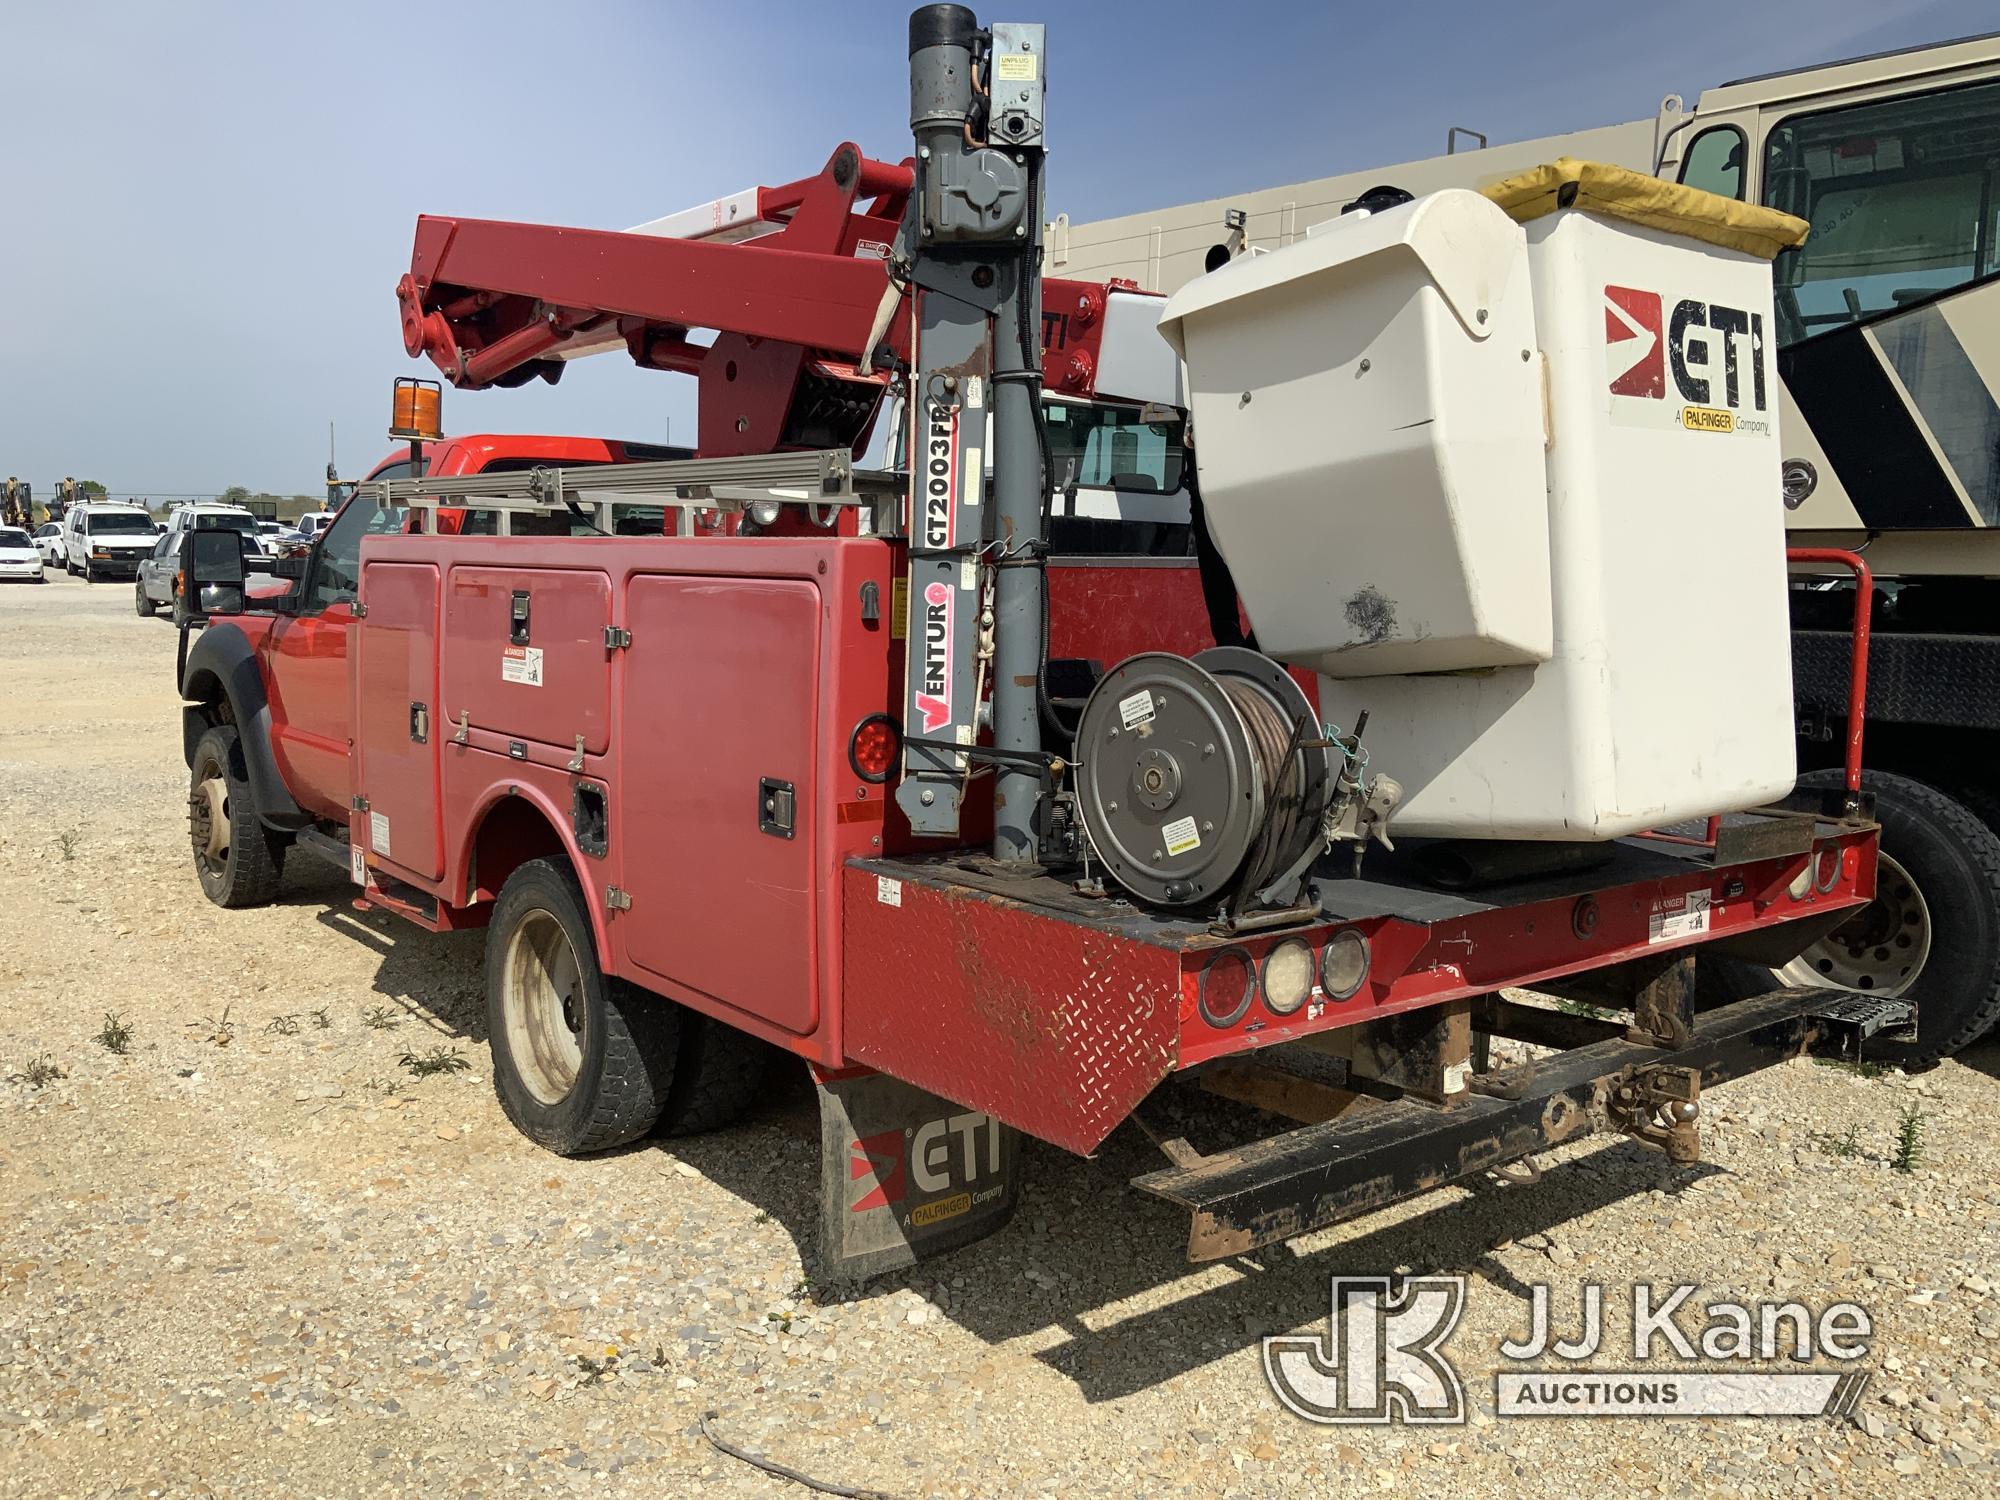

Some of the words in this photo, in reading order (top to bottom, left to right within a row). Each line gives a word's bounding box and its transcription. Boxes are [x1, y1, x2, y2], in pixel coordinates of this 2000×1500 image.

[1042, 311, 1069, 350] TI
[1669, 299, 1767, 412] ETI
[1675, 410, 1681, 424] A
[1686, 411, 1732, 428] PALFINGER
[1736, 416, 1769, 435] Company
[508, 649, 525, 657] DANGER
[916, 582, 954, 735] VENTURO
[912, 1112, 1000, 1193] ETI
[904, 1214, 911, 1226] A
[915, 1196, 969, 1224] PALFINGER
[972, 1184, 1004, 1205] Company
